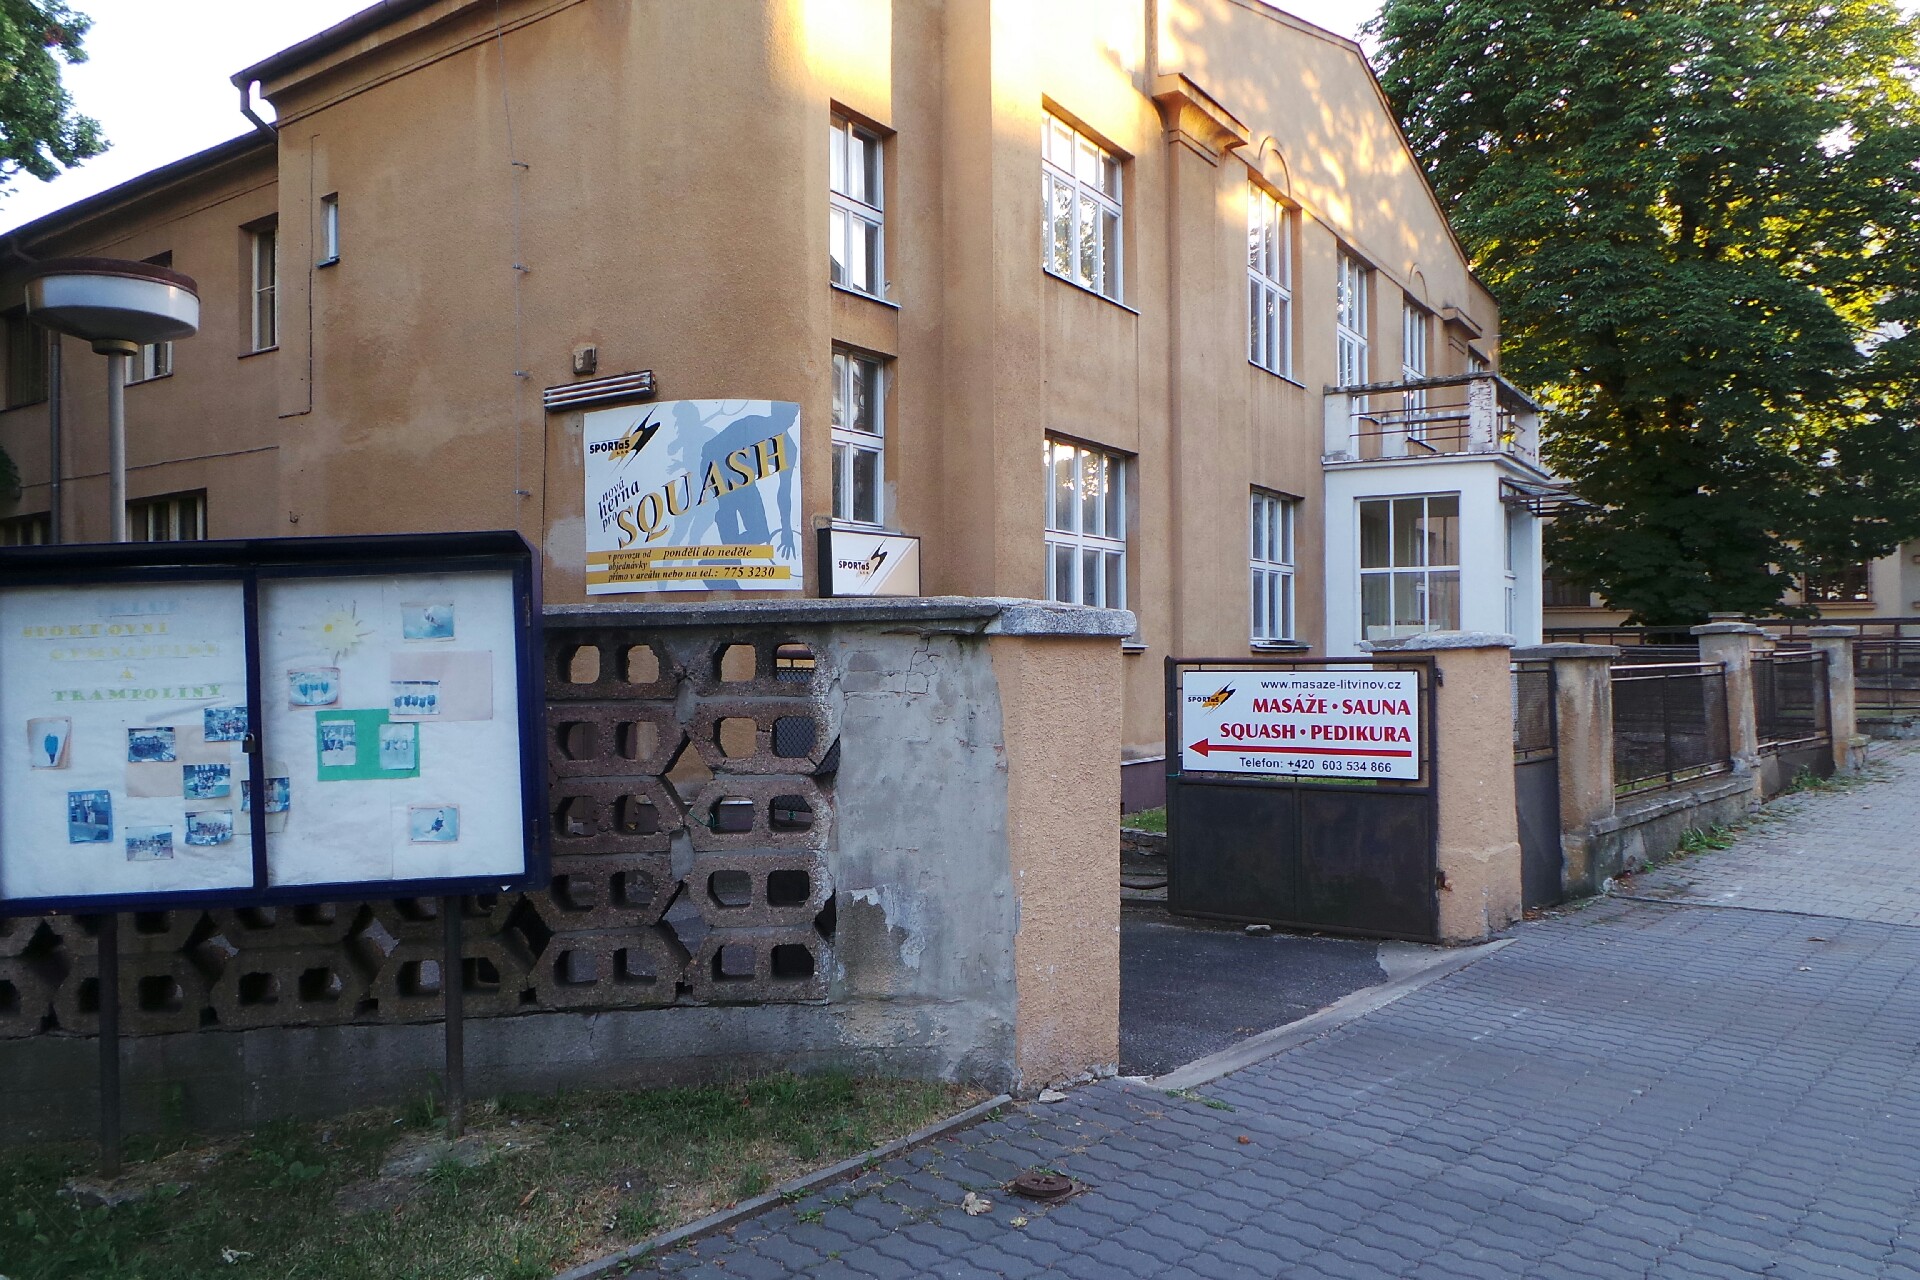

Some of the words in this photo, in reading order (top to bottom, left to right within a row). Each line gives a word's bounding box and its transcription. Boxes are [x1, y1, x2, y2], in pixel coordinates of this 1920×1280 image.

[602, 476, 624, 502] nová
[617, 432, 790, 550] SQUASH
[598, 481, 639, 519] herna
[602, 512, 617, 533] pro
[612, 552, 640, 562] provozu
[642, 550, 651, 558] od
[663, 547, 700, 560] pondělí
[702, 547, 715, 557] do
[717, 547, 752, 557] neděle
[608, 561, 647, 572] objednávky
[608, 571, 628, 583] přímo
[636, 570, 660, 580] areálu
[662, 570, 683, 579] nebo
[685, 570, 697, 578] na
[700, 569, 718, 578] tel.:
[724, 567, 744, 578] 775
[747, 566, 775, 578] 3230
[1261, 679, 1401, 691] www.masaze-litvinov.cz
[1252, 693, 1328, 714] MASÁŽE
[1342, 698, 1411, 715] SAUNA
[1220, 723, 1296, 740] SQUASH
[1310, 725, 1411, 742] PEDIKURA
[1239, 757, 1283, 769] Telefon:
[1287, 759, 1315, 770] +420
[1322, 760, 1342, 771] 603
[1346, 761, 1367, 772] 534
[1371, 762, 1392, 773] 866
